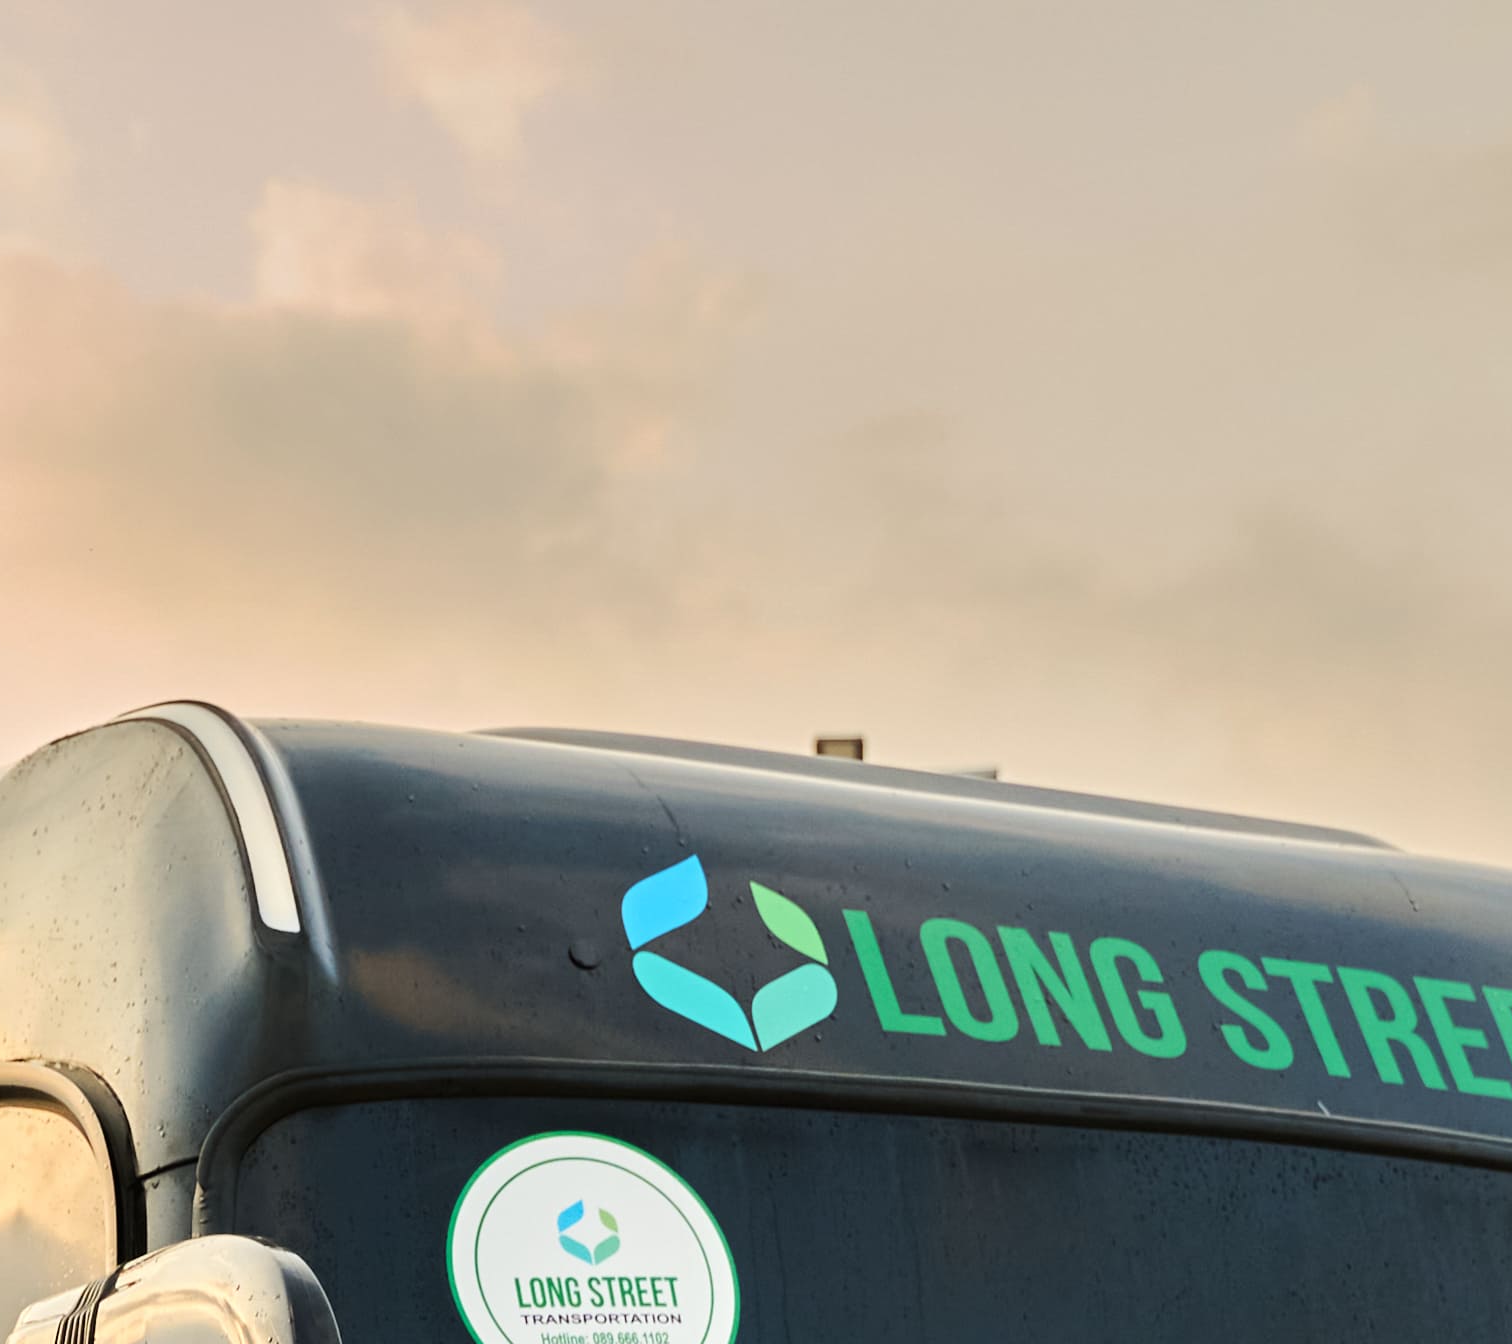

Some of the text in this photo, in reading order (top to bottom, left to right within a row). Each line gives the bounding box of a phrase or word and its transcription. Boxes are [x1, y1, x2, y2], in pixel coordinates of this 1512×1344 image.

[842, 909, 1187, 1060] LONG
[514, 1276, 678, 1308] LONG STREET
[520, 1313, 682, 1325] TRANSPORTATION
